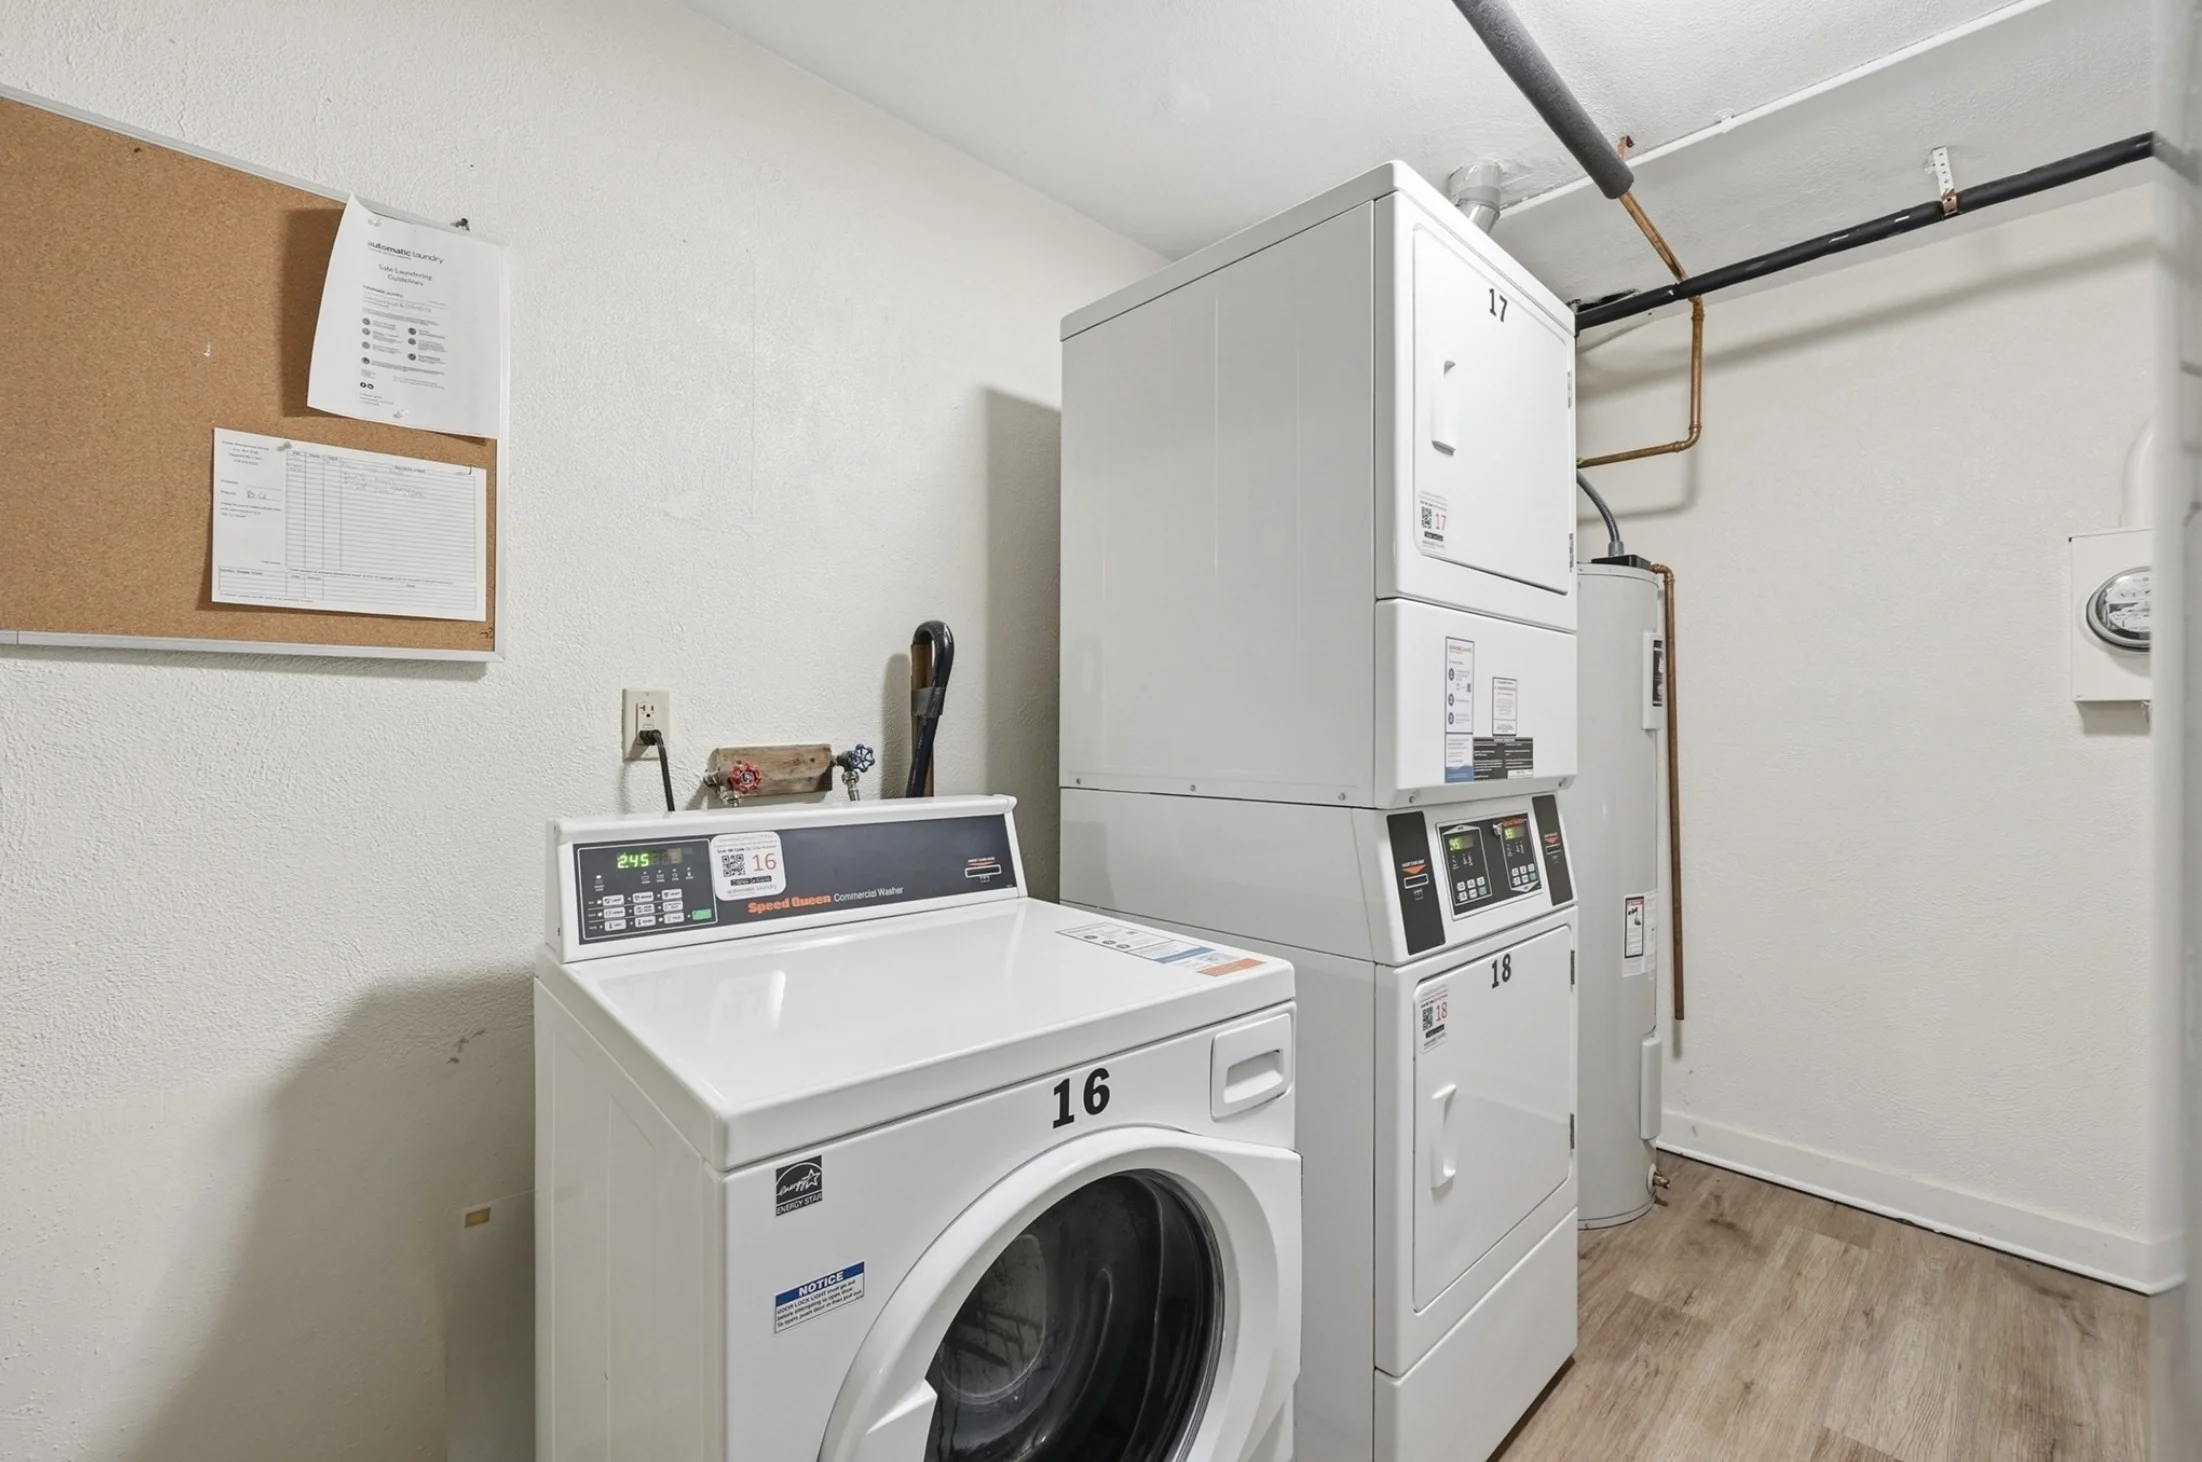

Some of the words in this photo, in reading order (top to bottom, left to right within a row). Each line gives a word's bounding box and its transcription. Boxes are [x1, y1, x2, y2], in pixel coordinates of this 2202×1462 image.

[367, 240, 411, 257] automatic
[413, 251, 444, 264] laundry
[378, 264, 394, 272] Safe
[395, 268, 433, 281] Laundering
[1489, 288, 1507, 322] 17
[1435, 513, 1447, 531] 17
[752, 852, 777, 872] 16
[748, 898, 790, 914] Speed
[791, 894, 832, 907] Queen
[833, 889, 877, 903] Commercial
[877, 886, 904, 897] Washer
[1491, 953, 1512, 989] 18
[1436, 1001, 1448, 1022] 18
[1053, 1067, 1110, 1129] 16
[777, 1199, 804, 1215] ENERGY
[804, 1192, 822, 1204] STAR
[798, 1271, 844, 1297] NOTICE
[794, 1297, 810, 1308] LOCK
[810, 1290, 826, 1301] LIGHT
